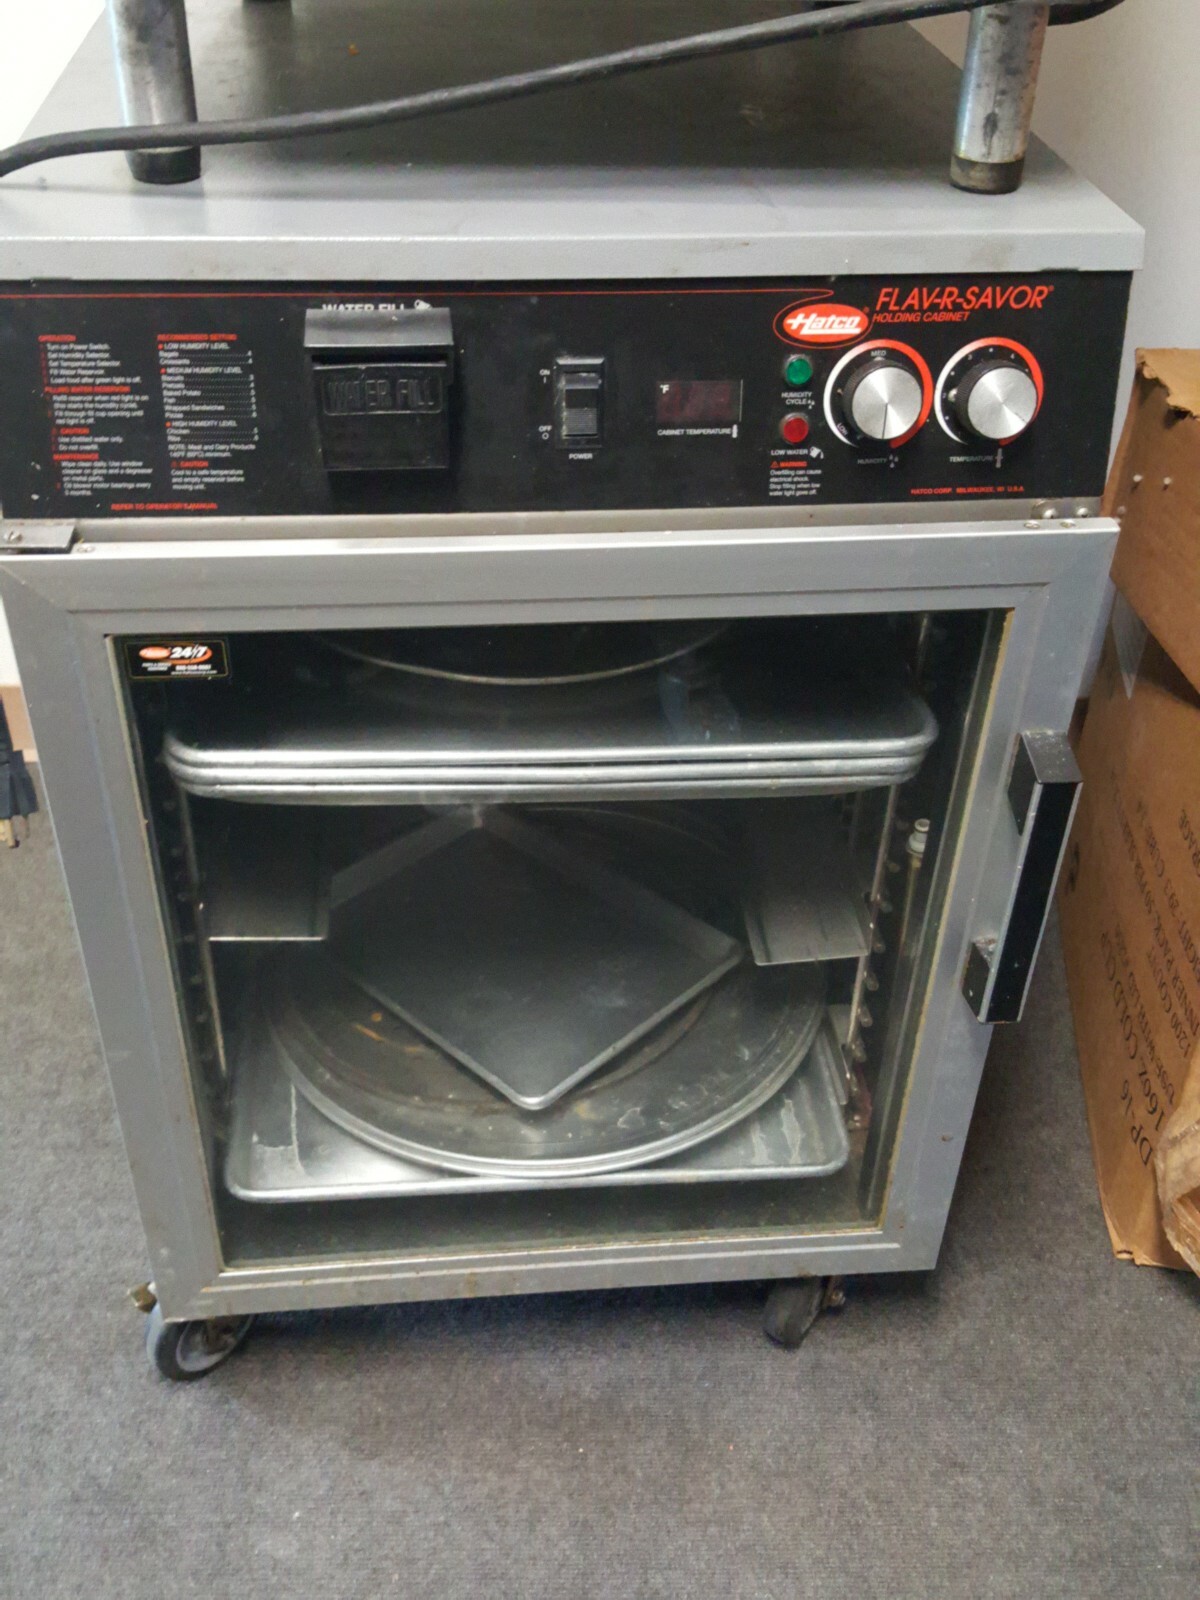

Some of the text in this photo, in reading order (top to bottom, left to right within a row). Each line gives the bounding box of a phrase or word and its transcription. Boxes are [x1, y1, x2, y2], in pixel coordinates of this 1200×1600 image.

[786, 312, 861, 335] Hatco
[872, 311, 970, 323] HOLDING CABINET
[210, 342, 230, 350] LEVEL
[870, 349, 886, 358] MED
[60, 360, 96, 368] Temperature
[223, 366, 243, 374] LEVEL
[327, 378, 435, 407] WATER FILL
[836, 422, 848, 436] LOW
[170, 644, 208, 659] 24/7
[1101, 931, 1116, 981] CUP
[1147, 944, 1172, 1014] COUNT
[1114, 980, 1137, 1060] COLD
[1170, 1012, 1190, 1058] 1200
[1120, 1079, 1153, 1166] DP-16
